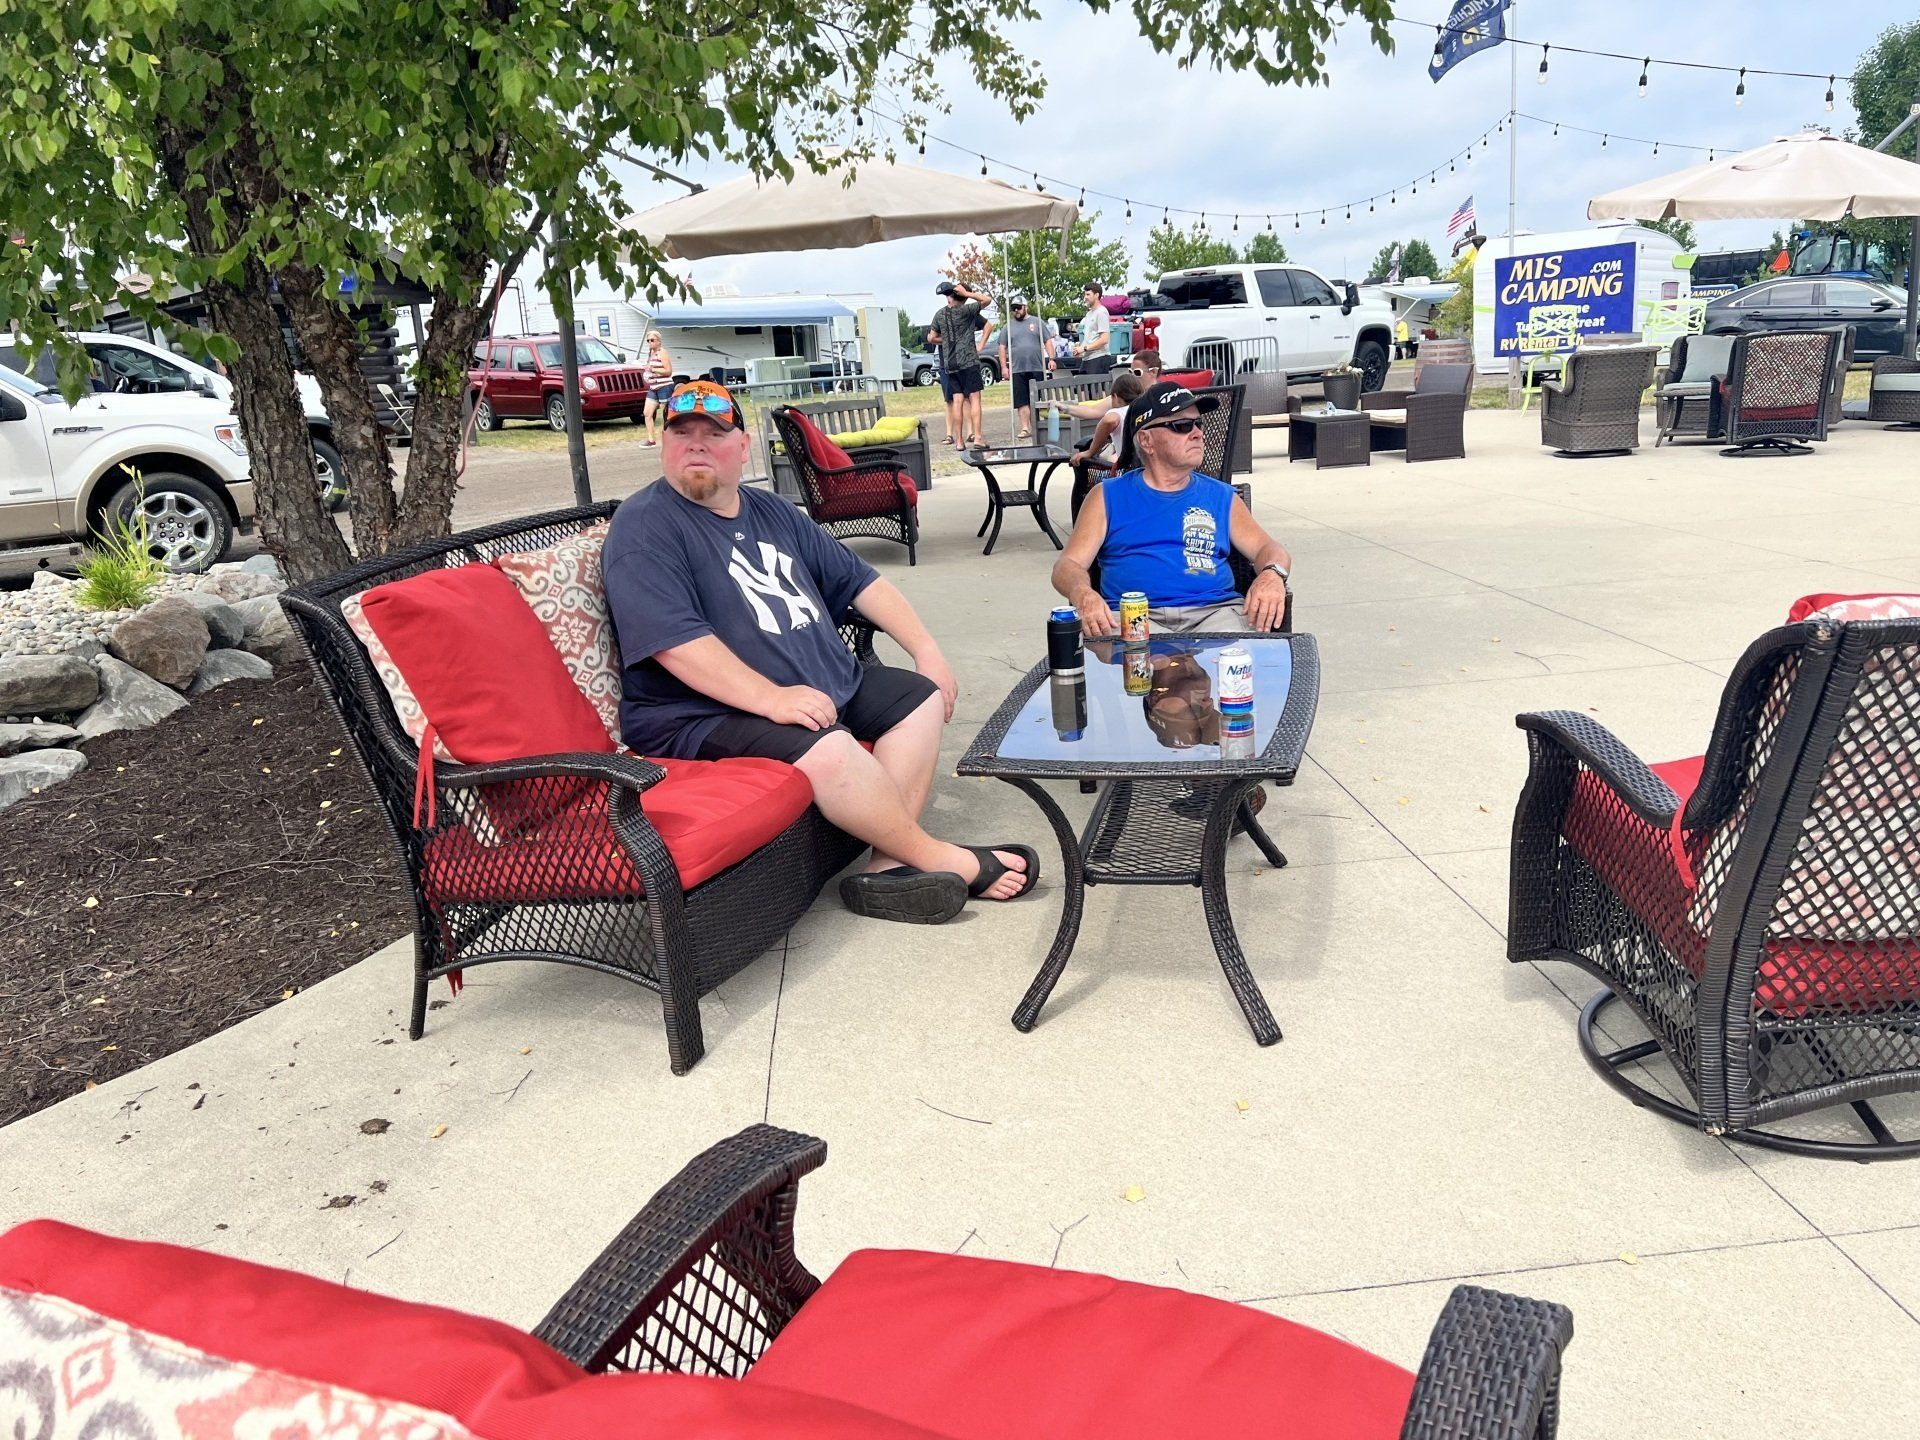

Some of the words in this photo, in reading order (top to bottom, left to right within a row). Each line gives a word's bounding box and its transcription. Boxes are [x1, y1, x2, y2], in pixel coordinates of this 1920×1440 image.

[1509, 255, 1562, 282] MIS
[1590, 260, 1622, 273] .COM
[1501, 273, 1624, 305] CAMPING
[1690, 289, 1733, 297] AMPING
[1500, 338, 1519, 350] RV
